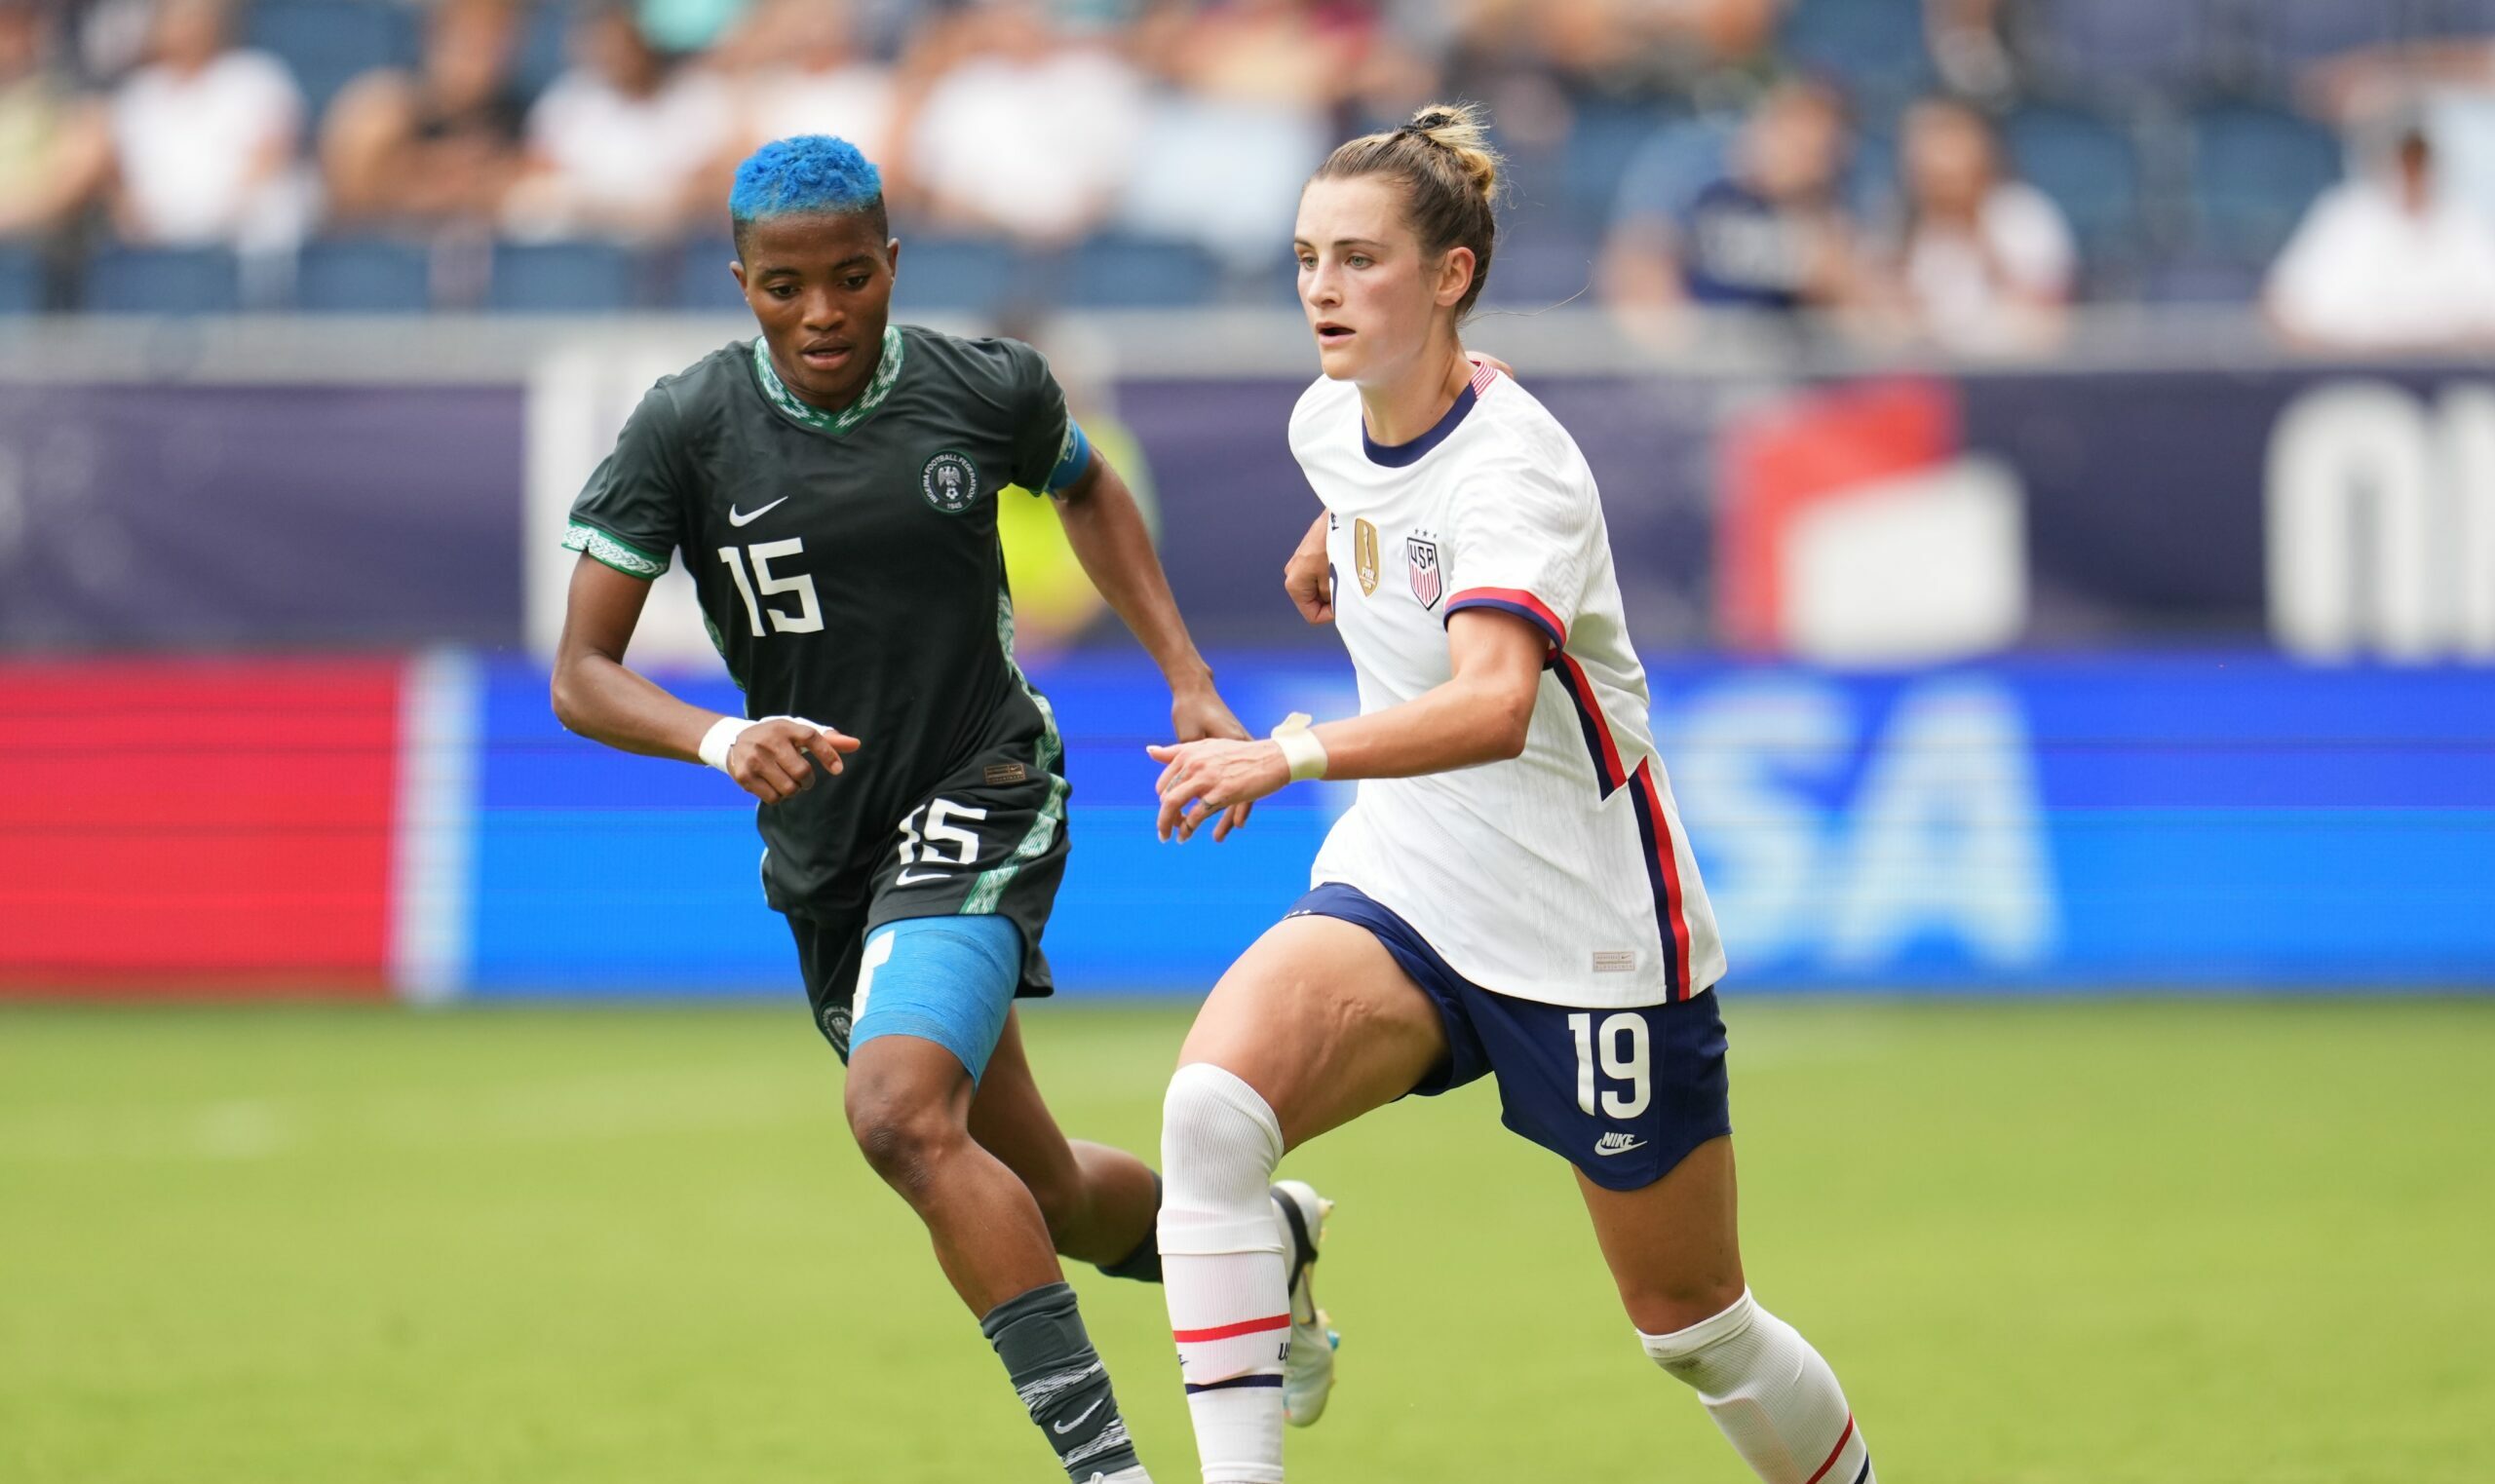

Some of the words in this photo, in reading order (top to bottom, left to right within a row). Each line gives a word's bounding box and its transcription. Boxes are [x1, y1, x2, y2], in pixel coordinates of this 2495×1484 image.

[924, 454, 957, 475] FOOTBALL
[1410, 544, 1435, 569] USA
[717, 537, 825, 636] 15
[899, 798, 987, 865] 15
[1568, 1012, 1651, 1120] 19
[1601, 1132, 1635, 1149] NIKE
